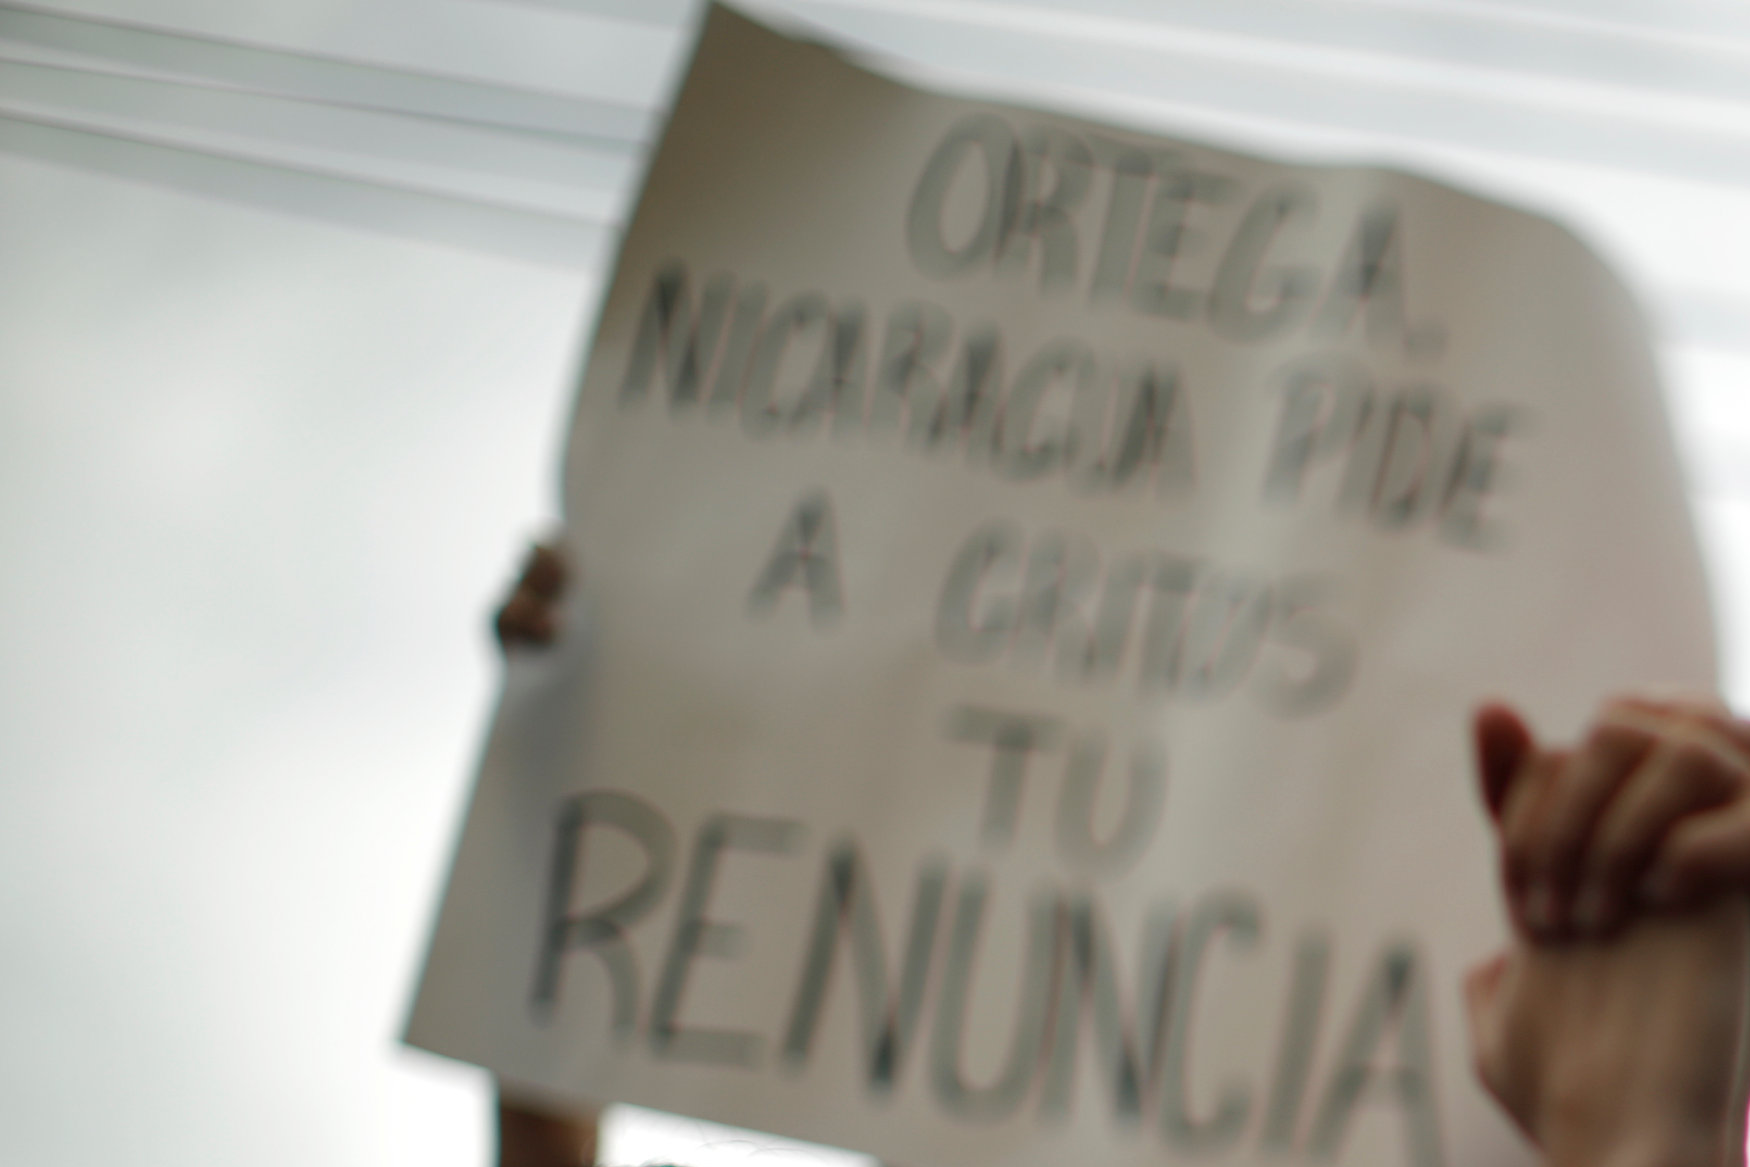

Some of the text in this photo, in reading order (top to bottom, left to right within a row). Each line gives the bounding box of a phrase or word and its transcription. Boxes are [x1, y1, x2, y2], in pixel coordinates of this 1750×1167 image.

[618, 262, 1534, 554] NICARAGUA PIDE
[748, 486, 1358, 720] A GRITOS
[940, 704, 1168, 878] TU
